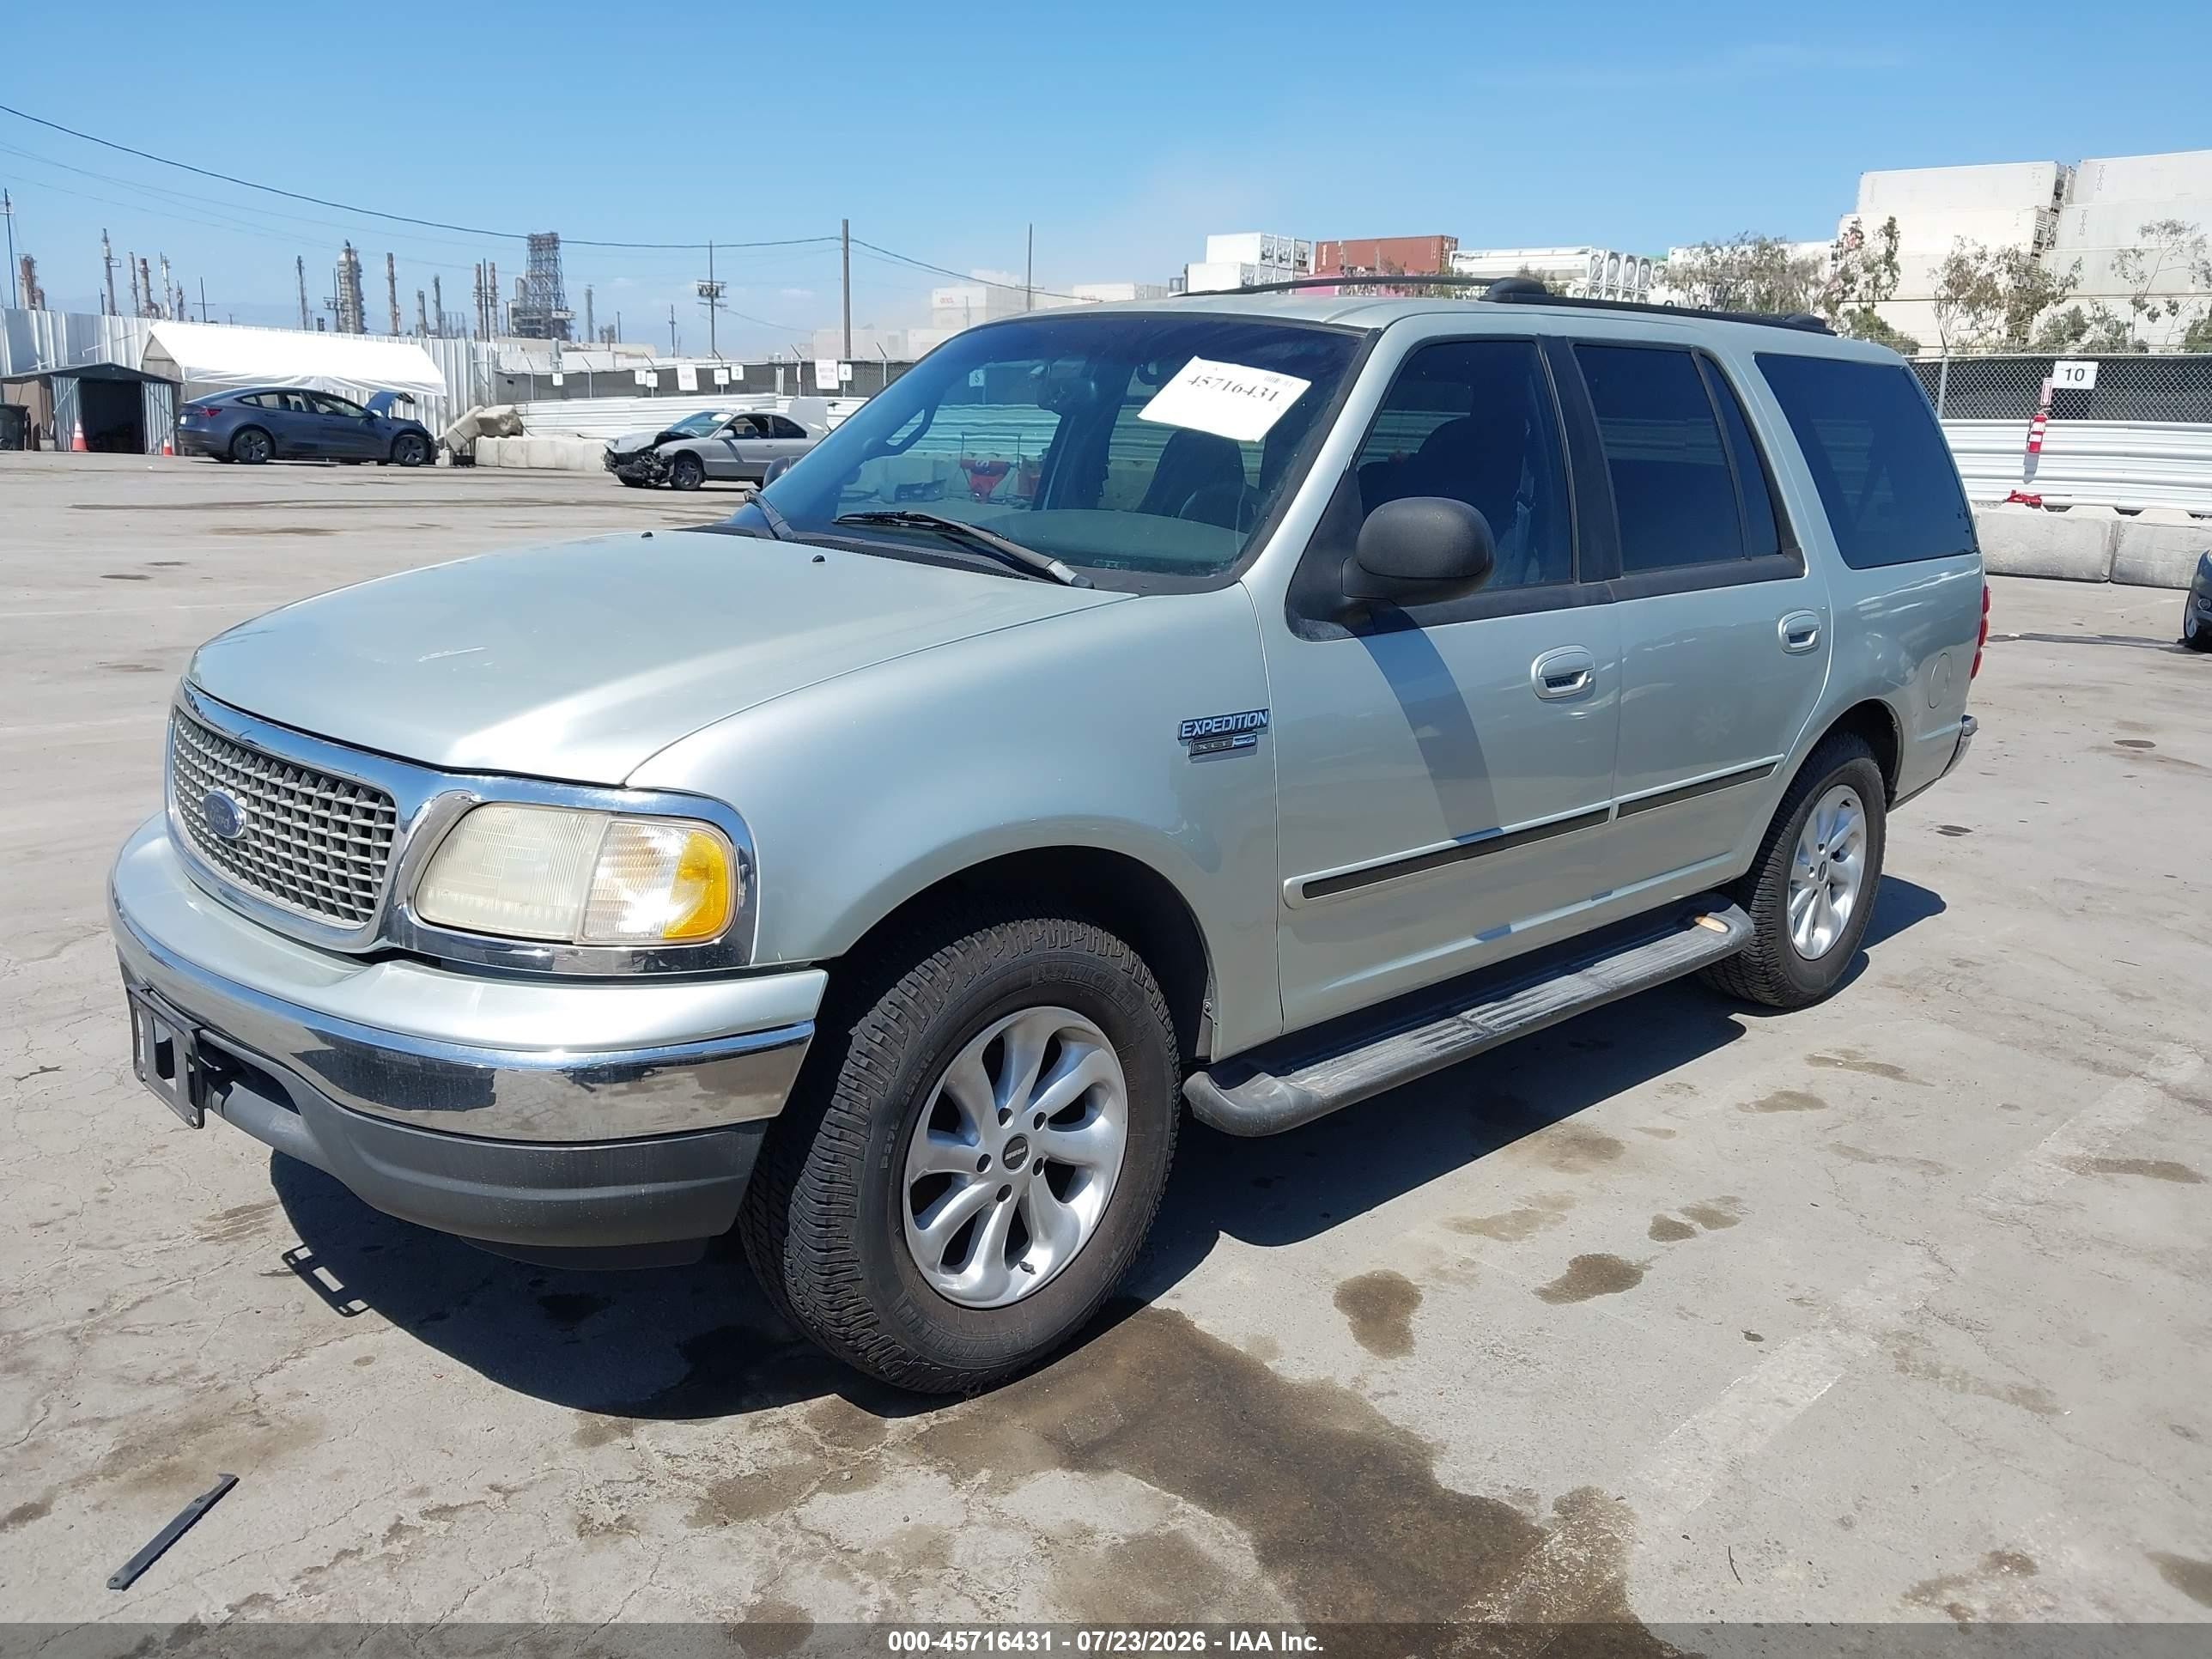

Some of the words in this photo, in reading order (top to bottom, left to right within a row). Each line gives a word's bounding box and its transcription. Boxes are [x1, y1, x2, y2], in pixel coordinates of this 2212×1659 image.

[1187, 374, 1279, 402] 45716431
[2064, 368, 2085, 382] 10
[1181, 710, 1269, 738] EXPEDITION
[209, 799, 232, 830] Ford
